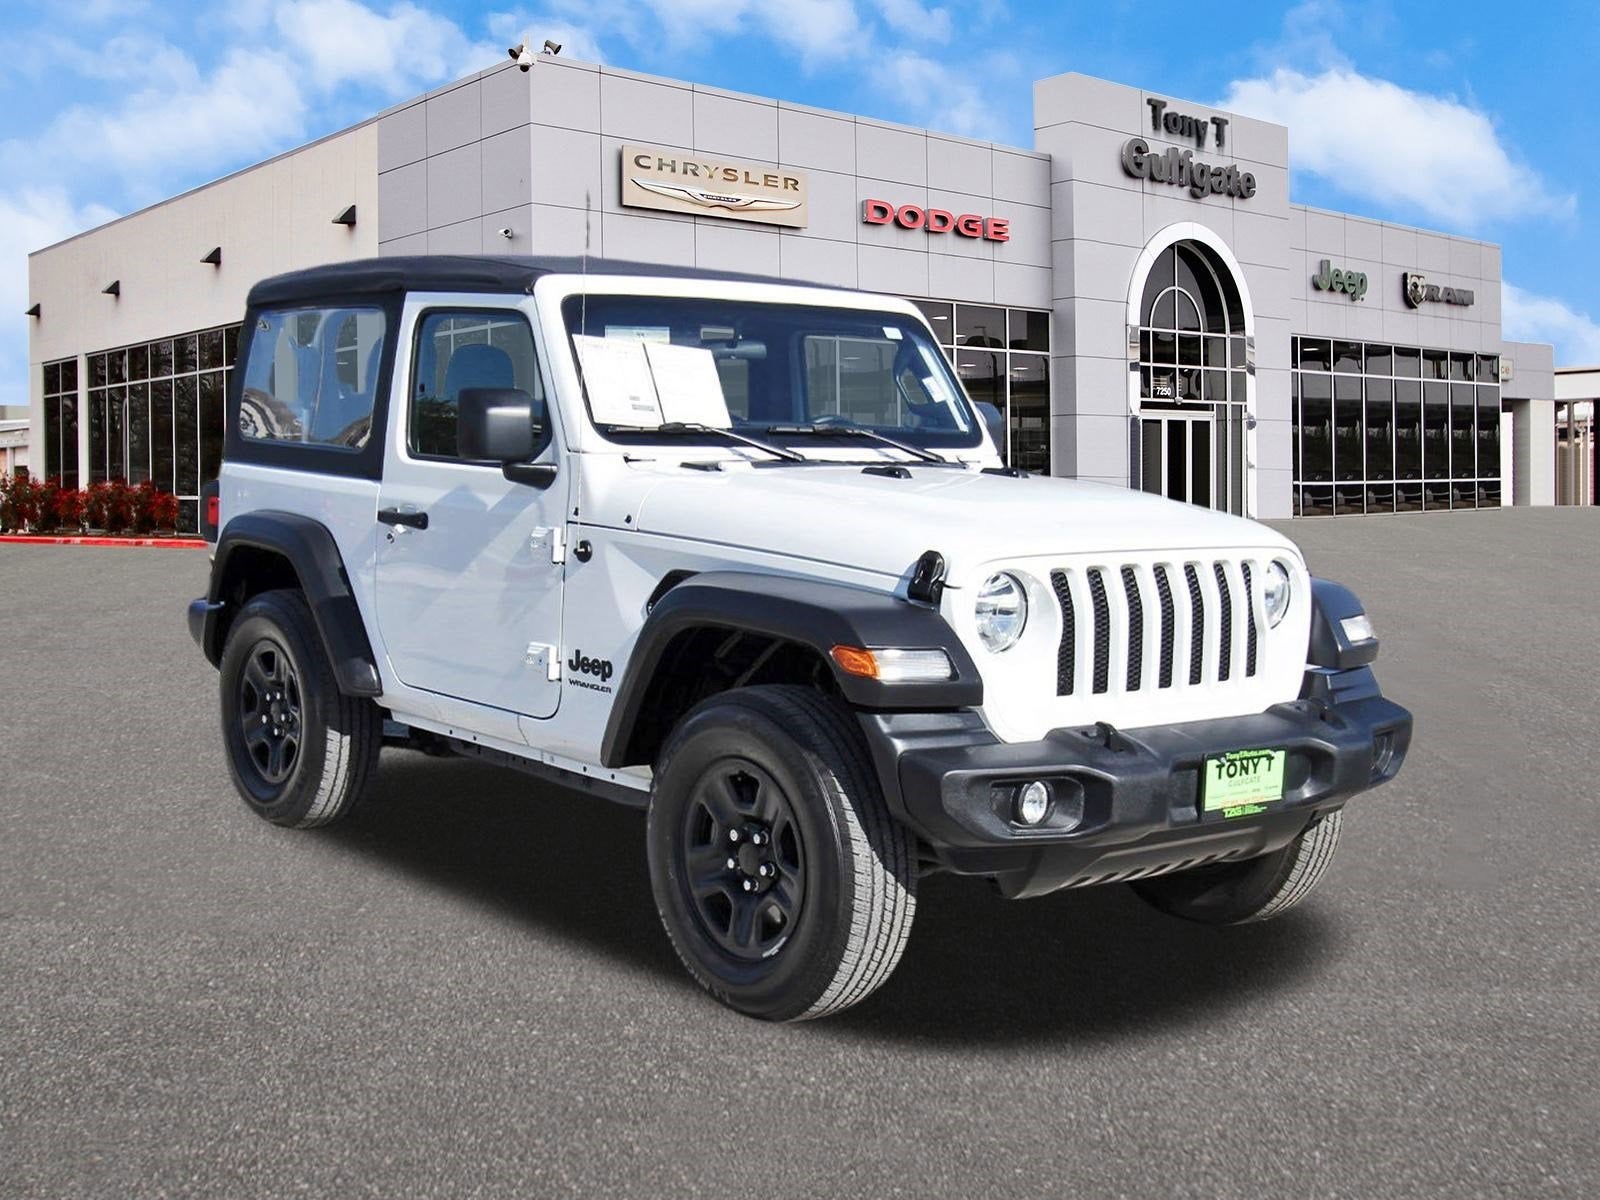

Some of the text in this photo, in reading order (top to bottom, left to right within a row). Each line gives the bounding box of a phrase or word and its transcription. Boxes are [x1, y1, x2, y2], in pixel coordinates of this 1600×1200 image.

[1147, 98, 1229, 147] Tony T
[634, 154, 800, 192] CHRYSLER
[1122, 138, 1256, 198] Gulfgate
[863, 199, 1010, 242] DODGE
[1312, 260, 1367, 302] Jeep
[1424, 284, 1475, 306] RAM
[1156, 387, 1172, 396] 7250
[568, 649, 613, 682] Jeep
[568, 678, 612, 694] WRANGLER
[1216, 754, 1275, 780] TONY T
